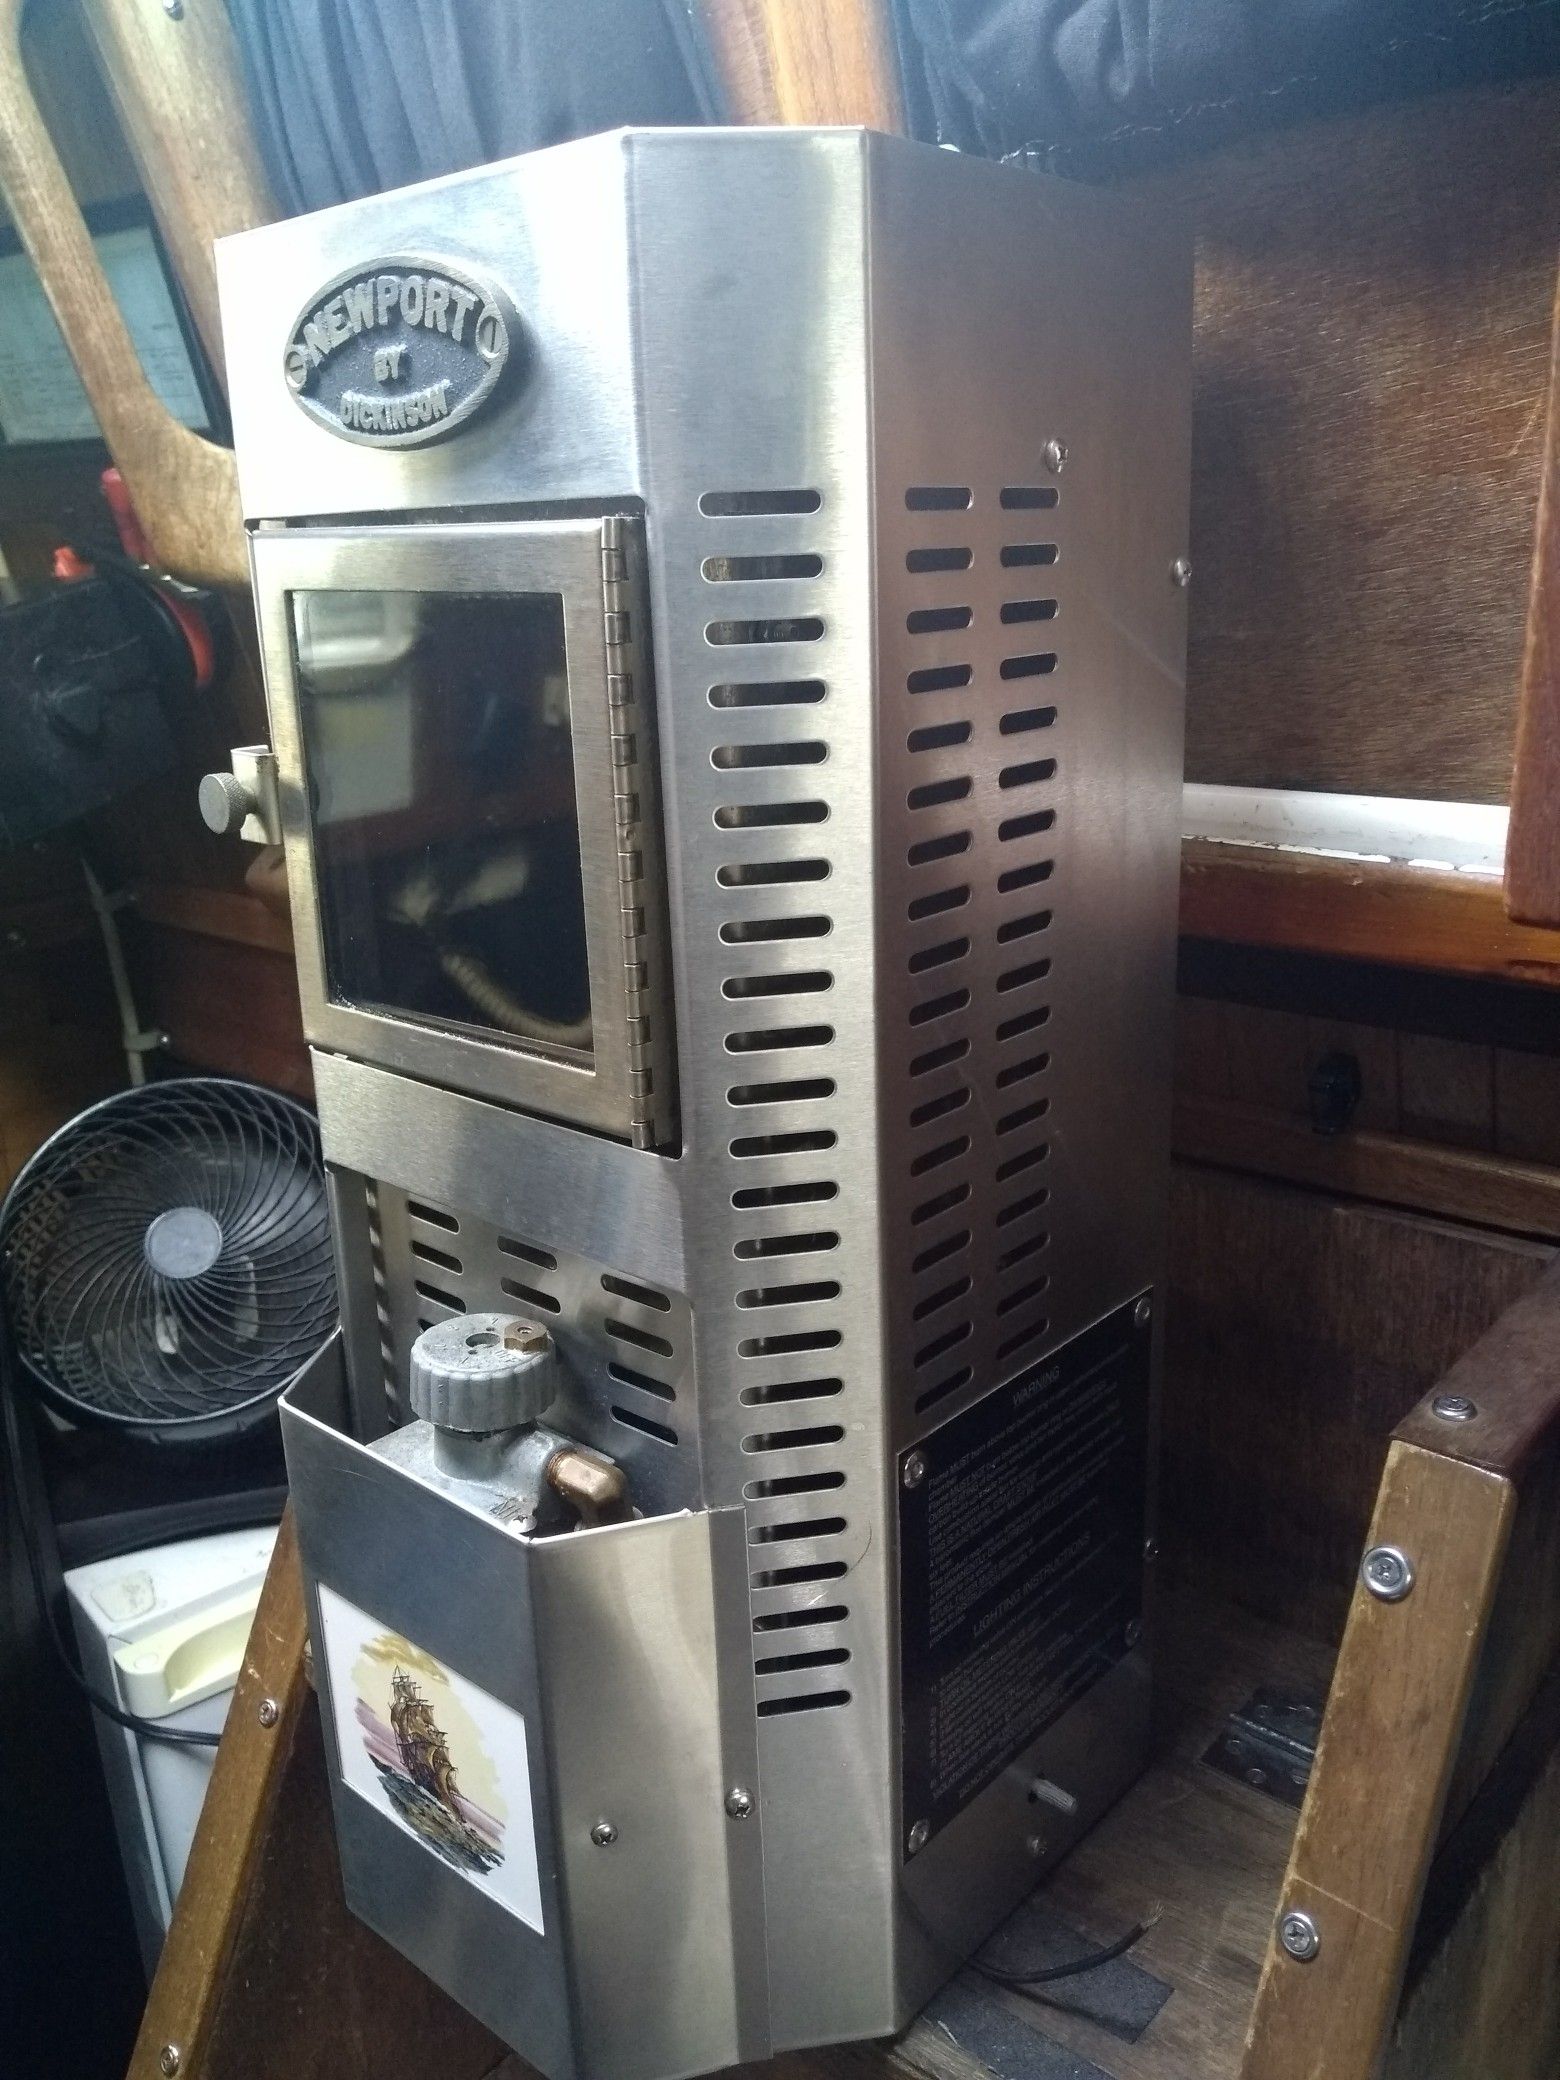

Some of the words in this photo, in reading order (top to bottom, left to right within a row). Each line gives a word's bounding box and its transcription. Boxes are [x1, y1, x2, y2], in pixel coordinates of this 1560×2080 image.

[303, 275, 479, 368] NEWPORT
[374, 344, 407, 383] BY
[339, 379, 452, 432] DICKINSON
[1013, 1366, 1060, 1406] WARNING
[973, 1588, 1021, 1638] LIGHTING
[1022, 1531, 1091, 1597] INSTRUCTIONS
